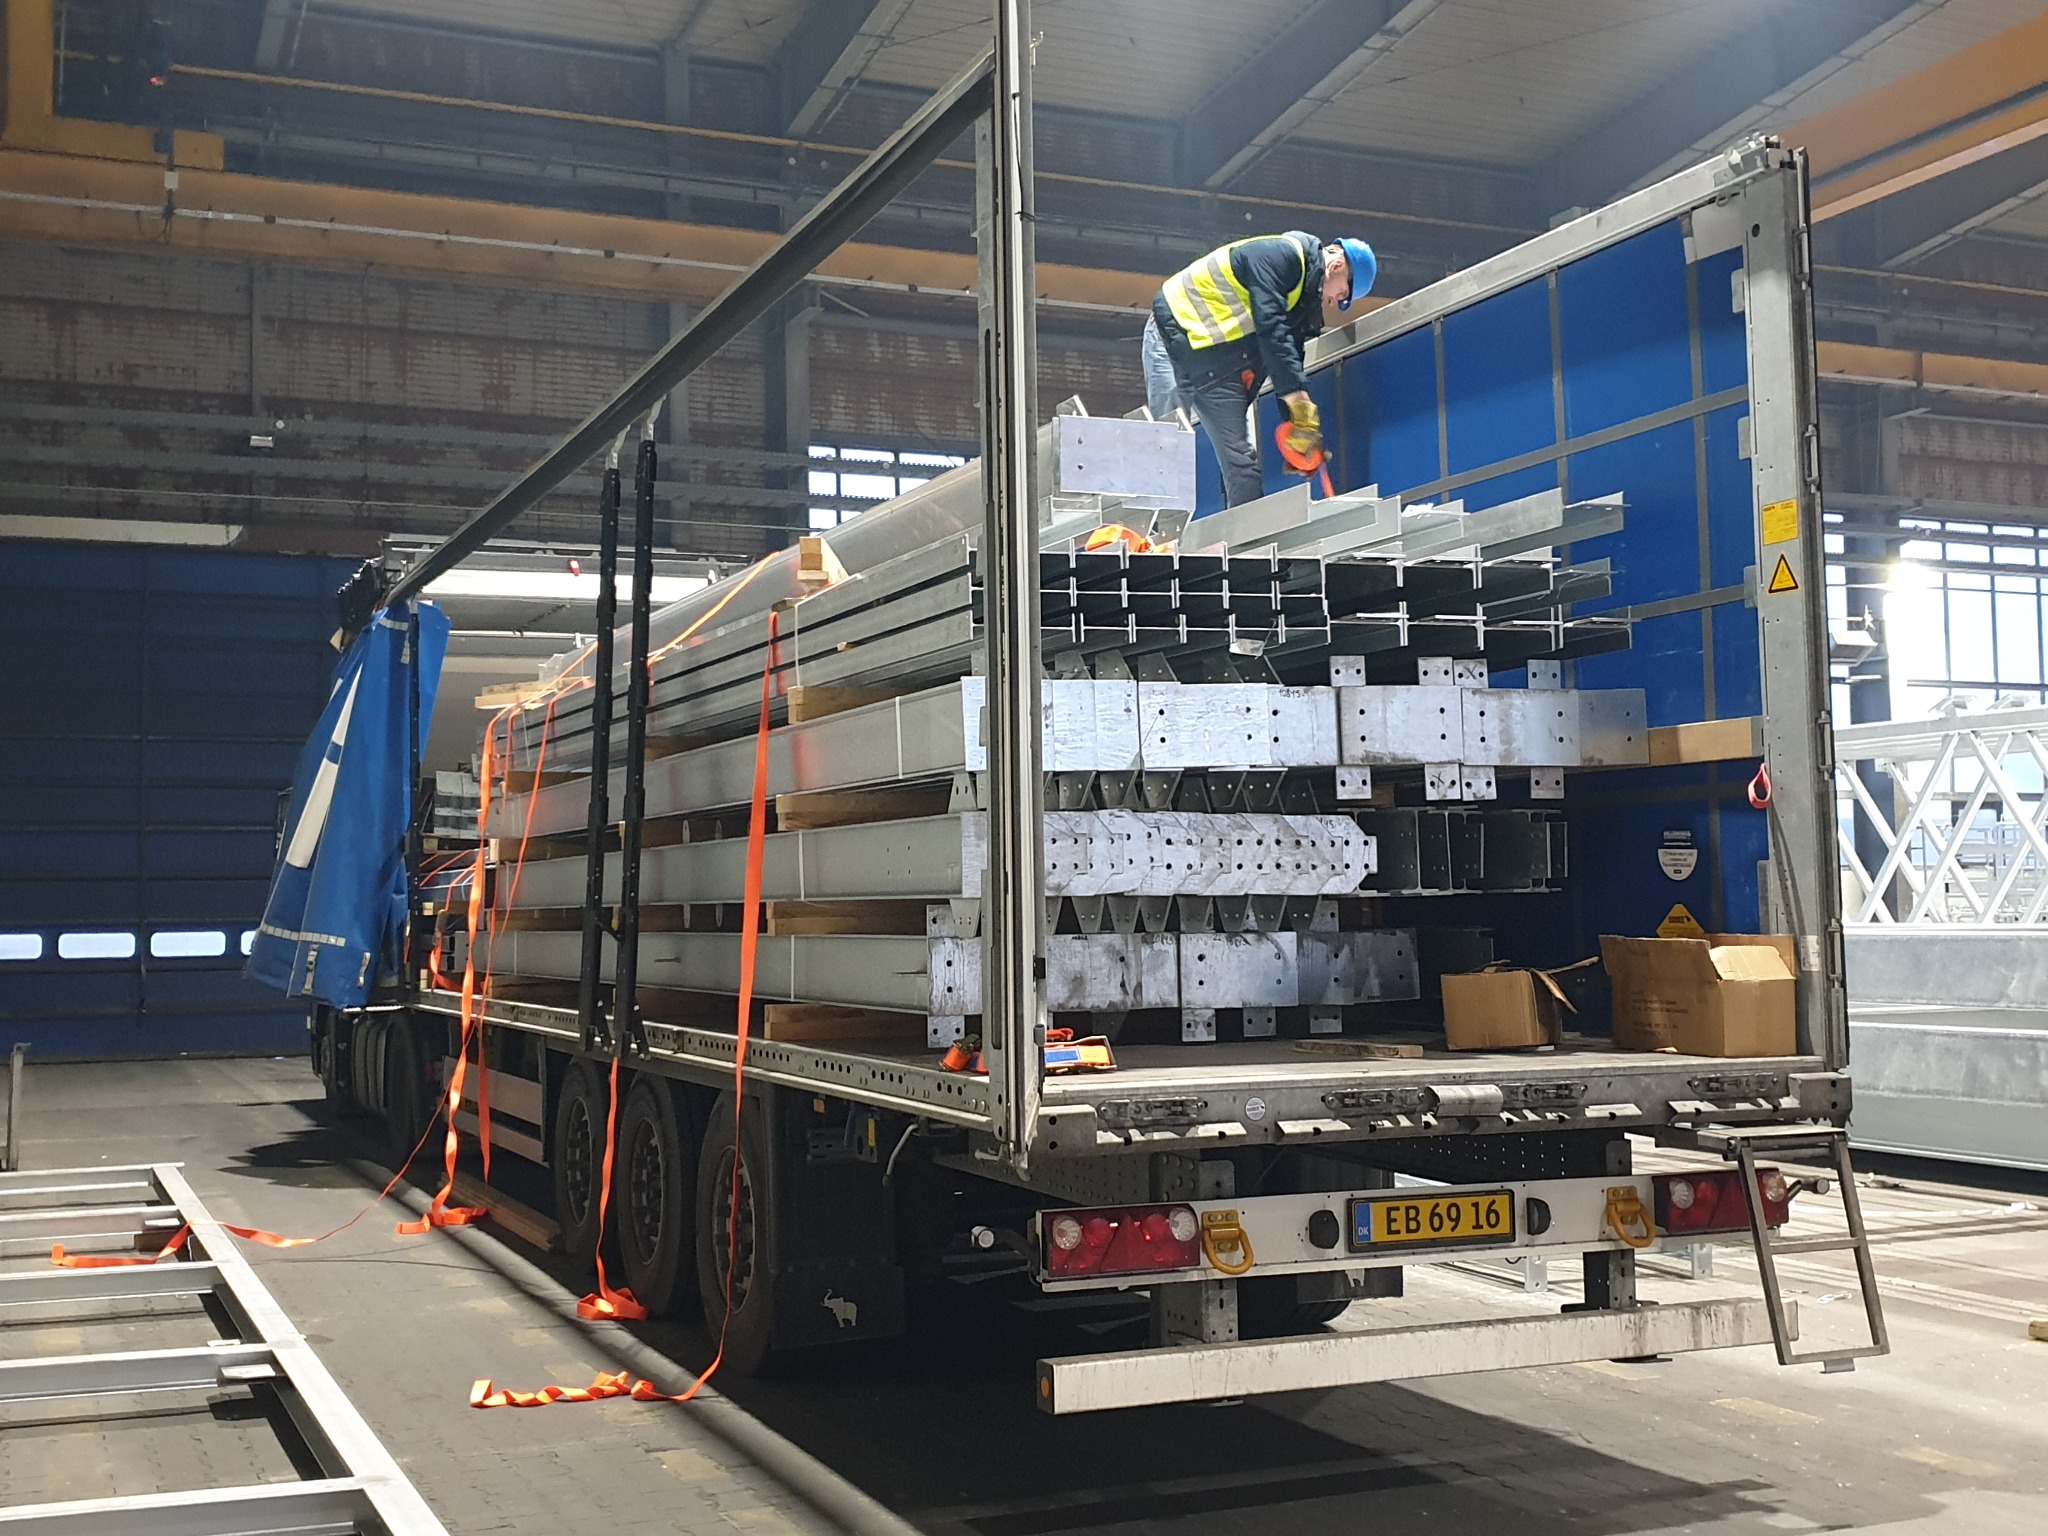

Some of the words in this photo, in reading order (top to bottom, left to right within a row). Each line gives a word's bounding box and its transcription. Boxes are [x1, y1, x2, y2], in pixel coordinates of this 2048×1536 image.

[1386, 1205, 1421, 1235] EB
[1429, 1202, 1461, 1232] 69
[1471, 1199, 1500, 1230] 16
[1358, 1226, 1369, 1236] DK
